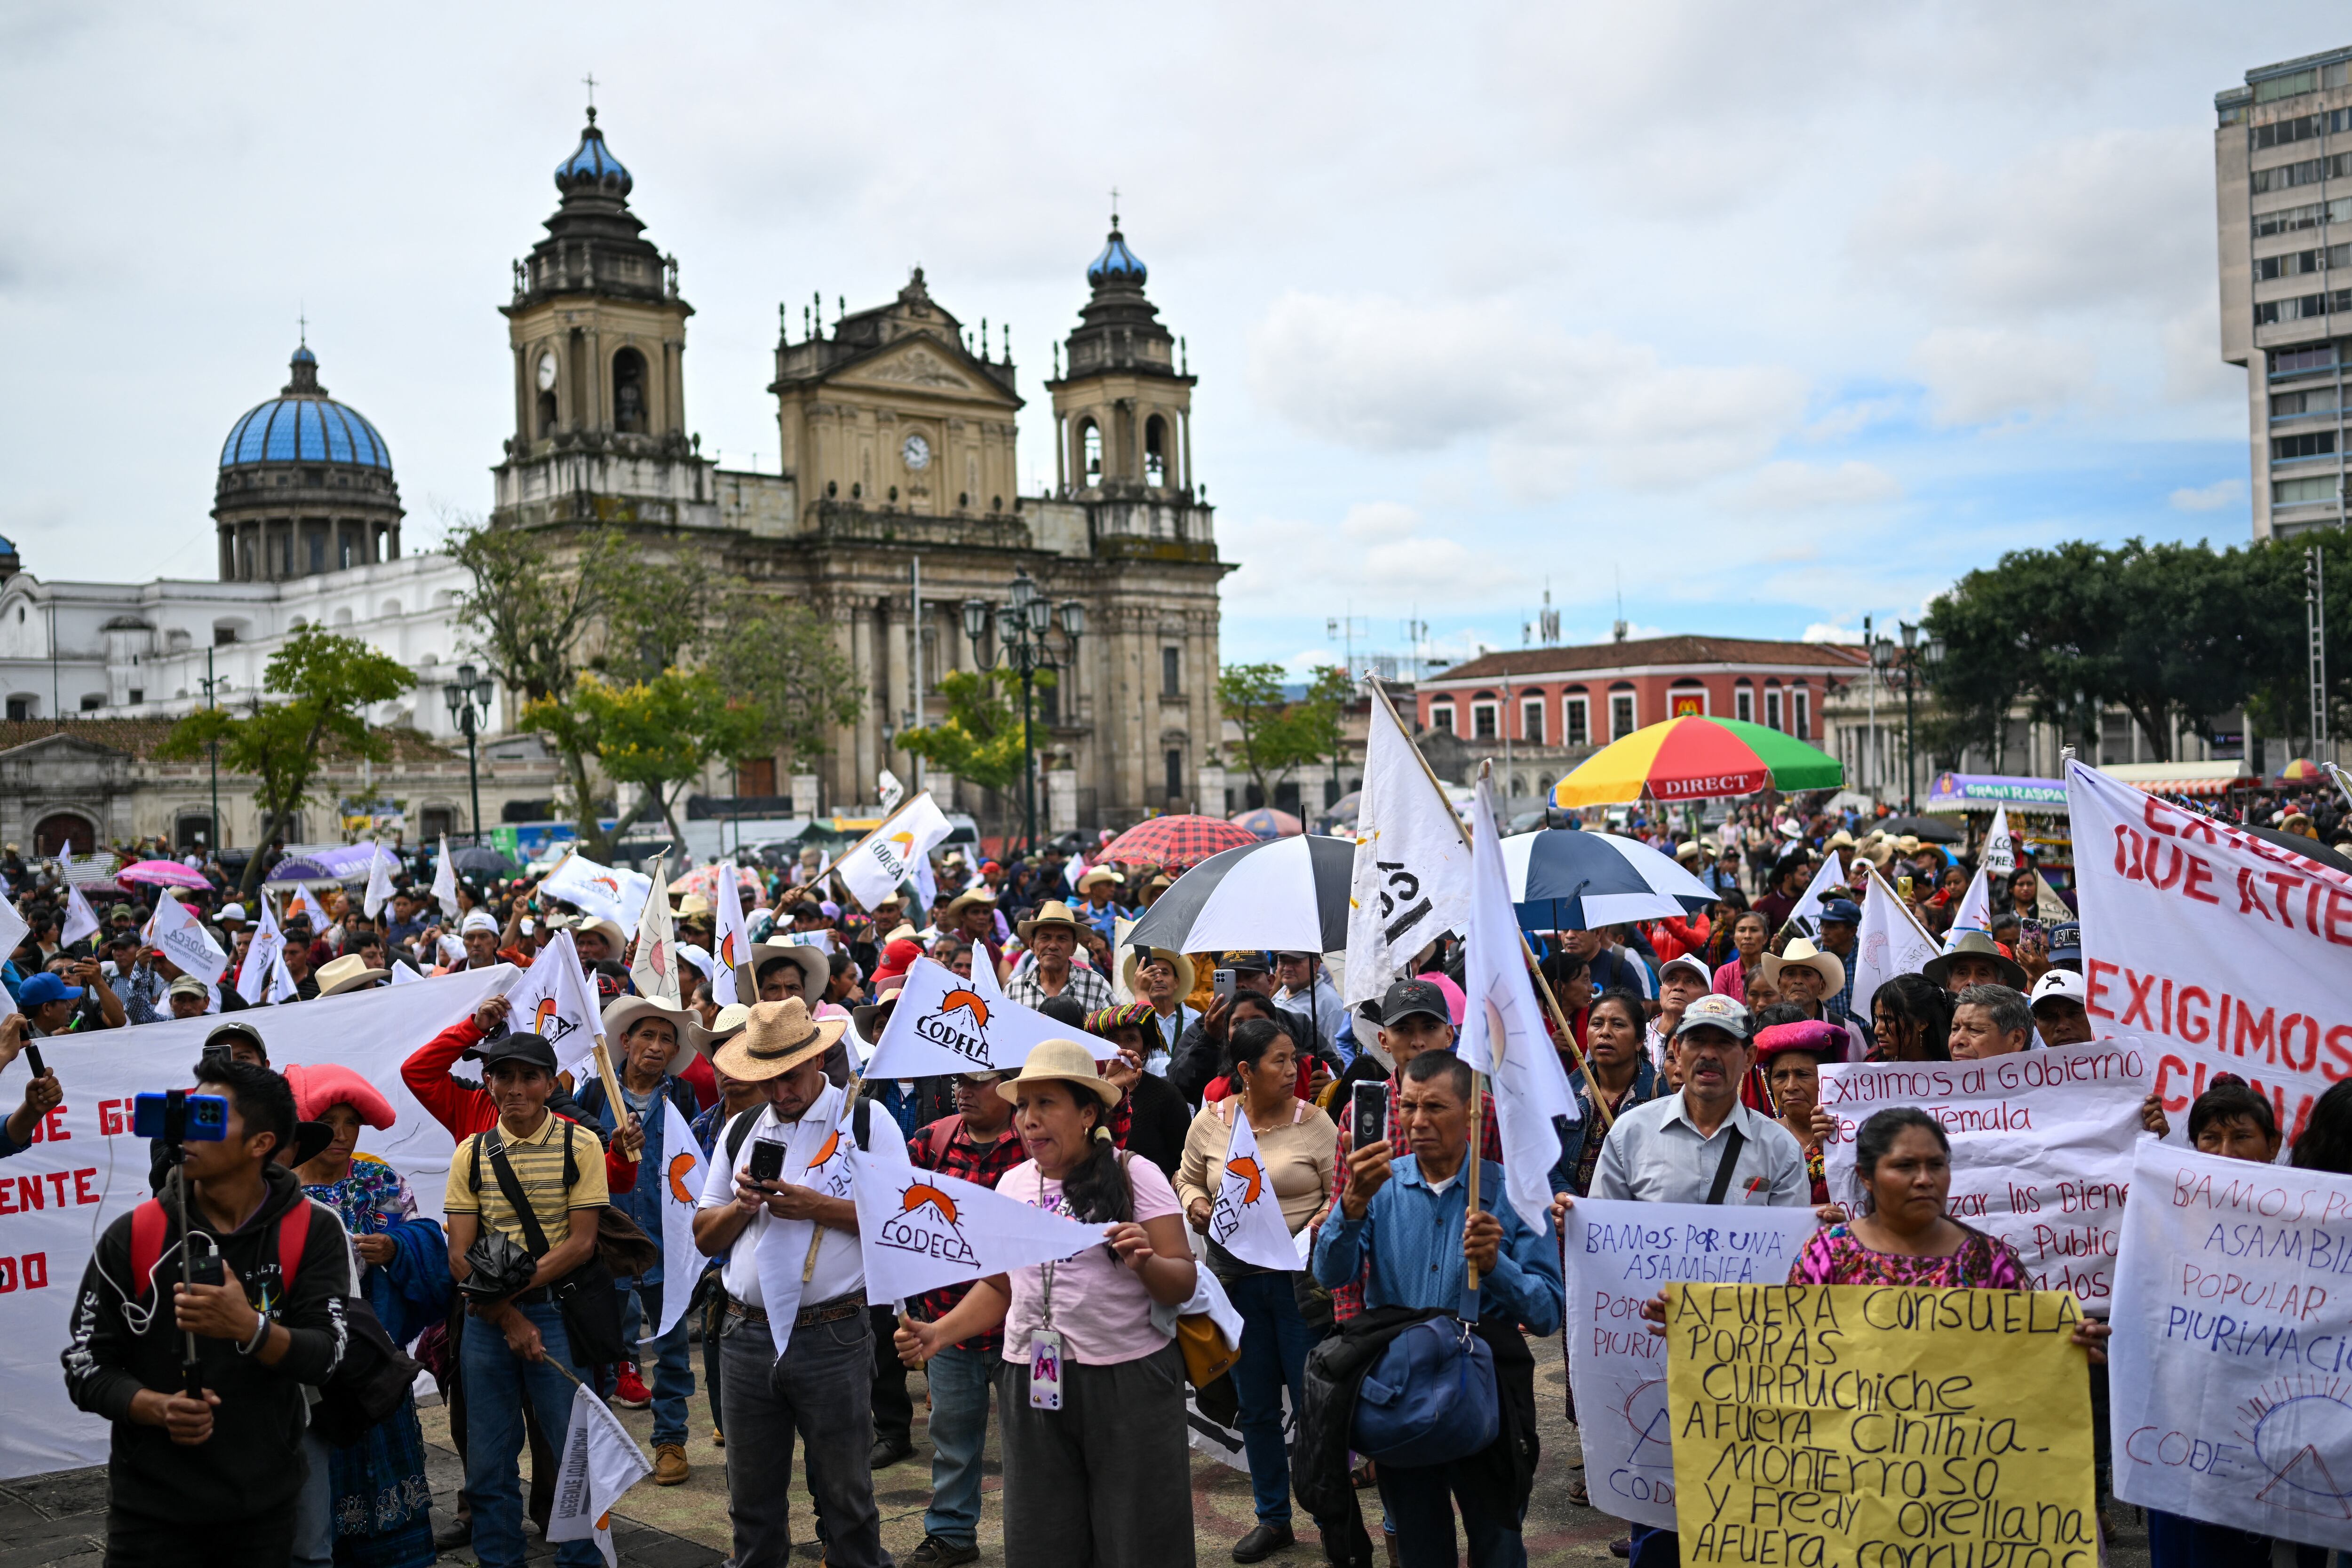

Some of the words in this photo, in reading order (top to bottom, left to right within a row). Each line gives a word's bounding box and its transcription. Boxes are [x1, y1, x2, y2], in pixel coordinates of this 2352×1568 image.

[1666, 775, 1749, 795] DIRECT
[1966, 784, 2009, 798] GRANI
[2011, 785, 2067, 801] RASPA
[870, 839, 904, 881] CODECA
[2114, 824, 2220, 905] QUE
[917, 1015, 989, 1062] CODECA
[2086, 958, 2352, 1083] EXIGIMOS
[1962, 1067, 1986, 1093] al
[0, 1167, 100, 1215] ENTE
[2008, 1181, 2041, 1215] los
[2055, 1179, 2130, 1213] Biene
[882, 1220, 974, 1260] CODECA
[2032, 1223, 2118, 1260] Public
[2031, 1265, 2110, 1301] ados
[1675, 1283, 1839, 1328] AFUERA
[1687, 1324, 1844, 1366] PORRAS
[1609, 1468, 1676, 1507] COD
[1704, 1482, 1731, 1523] Y
[1751, 1485, 1860, 1535] Fredy
